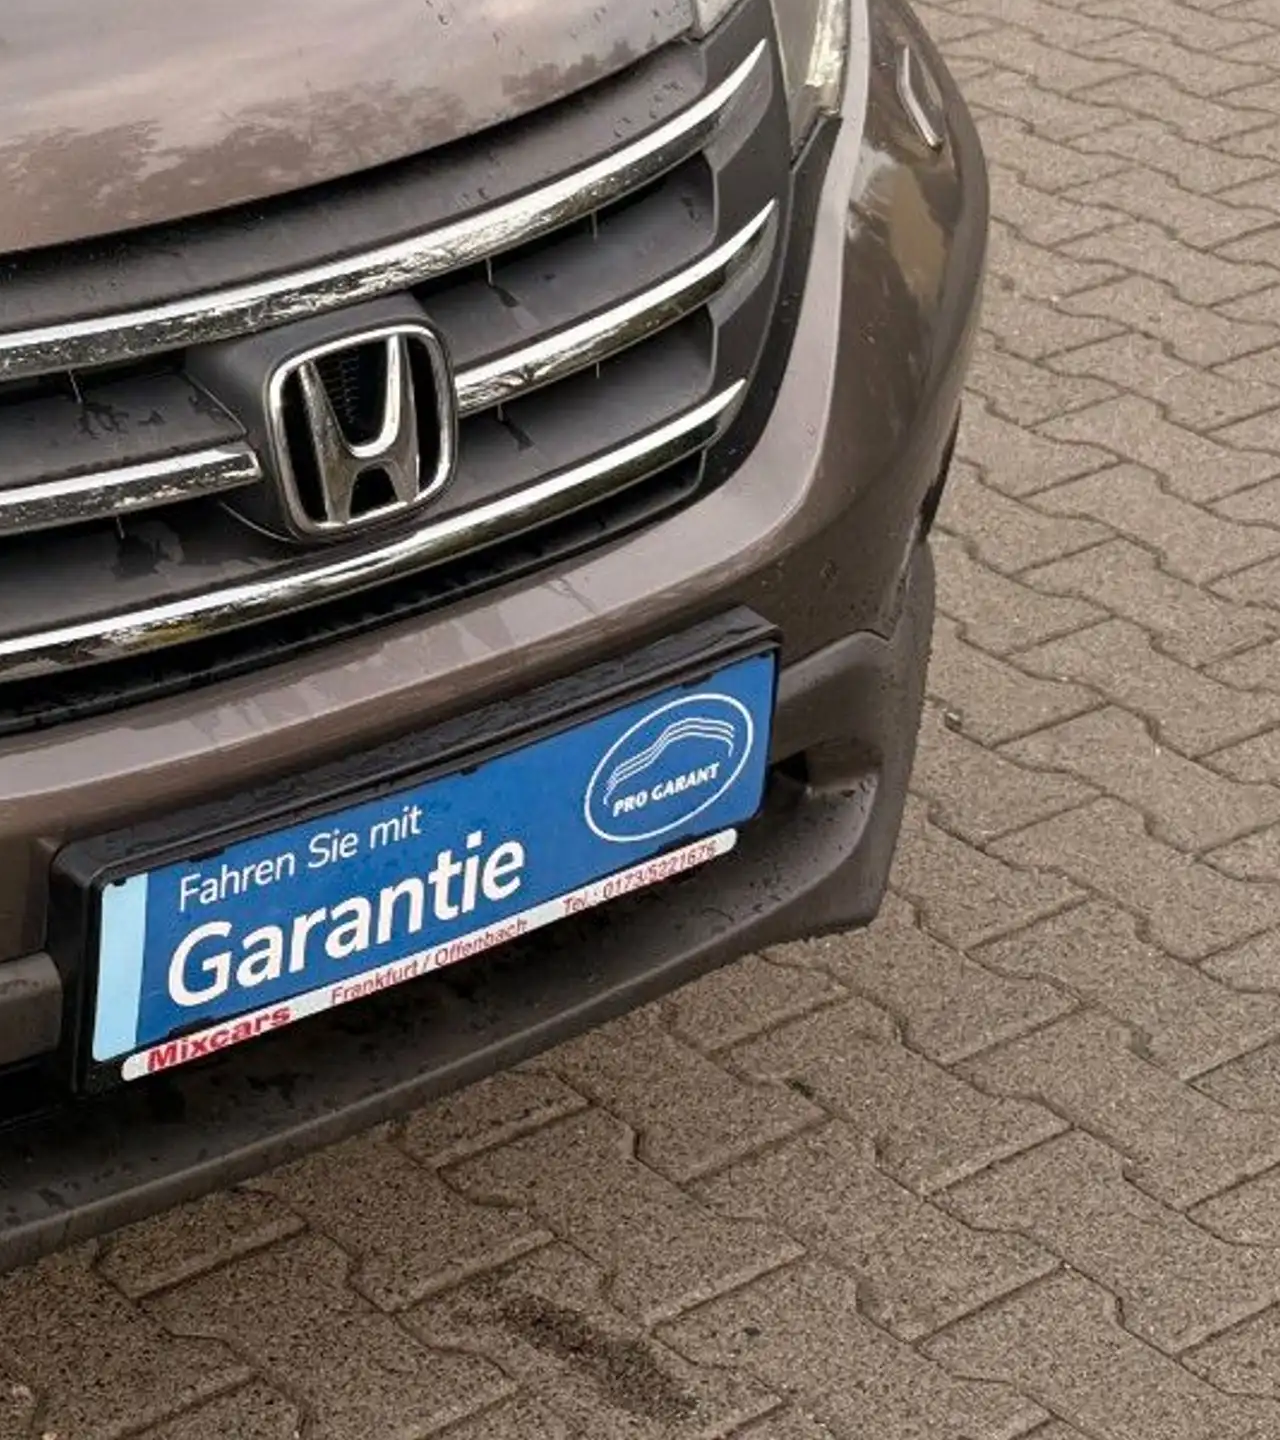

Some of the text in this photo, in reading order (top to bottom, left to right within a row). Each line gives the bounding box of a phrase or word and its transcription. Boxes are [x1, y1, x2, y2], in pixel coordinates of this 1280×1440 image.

[612, 761, 720, 817] PRO GARANT
[167, 830, 527, 1007] Garantie
[179, 805, 423, 911] Fahren Sie mit
[146, 1006, 293, 1072] Mixcars
[331, 957, 419, 1006] Frankfurt
[434, 917, 528, 968] Offenbach
